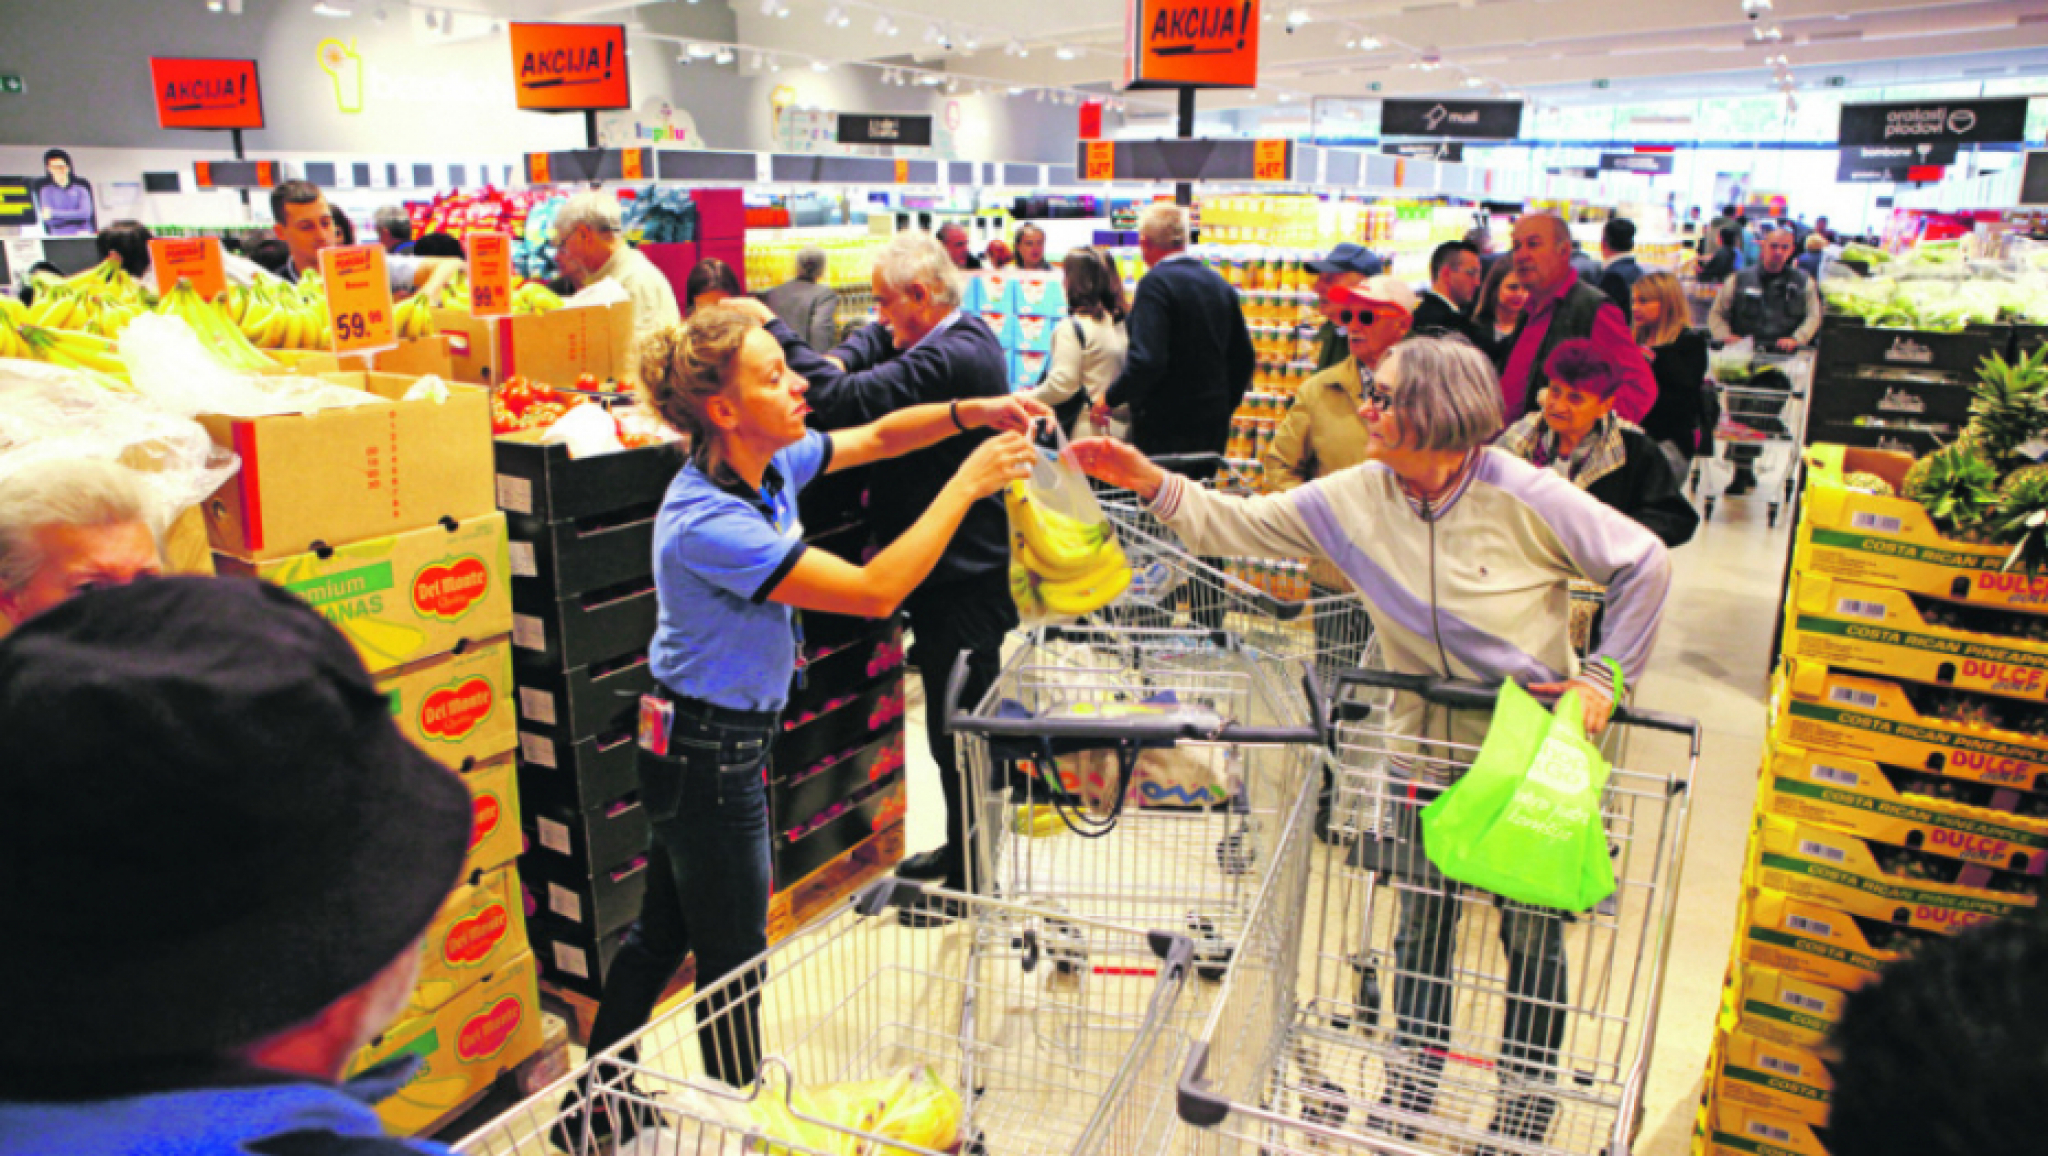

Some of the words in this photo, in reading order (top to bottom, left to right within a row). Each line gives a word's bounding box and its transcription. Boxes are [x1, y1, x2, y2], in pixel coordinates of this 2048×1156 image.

[1151, 1, 1252, 50] AKCIJA!
[521, 39, 614, 80] AKCIJA!
[164, 72, 248, 106] AKCIJA!
[1861, 538, 1918, 558] COSTA
[1921, 548, 1979, 568] RICAN
[1978, 571, 2048, 597] DULC
[1846, 625, 1901, 644] COSTA
[1904, 633, 1962, 654] RICAN
[1962, 659, 2044, 687] DULCE
[1837, 711, 1893, 733] COSTA
[1895, 723, 1952, 744] RICAN
[1951, 750, 2031, 777] DULCE
[1821, 789, 1874, 810] COSTA
[1877, 802, 1933, 823] RICAN
[1930, 827, 2009, 856] DULCE
[1807, 863, 1860, 885] COSTA
[1795, 937, 1847, 961] COSTA
